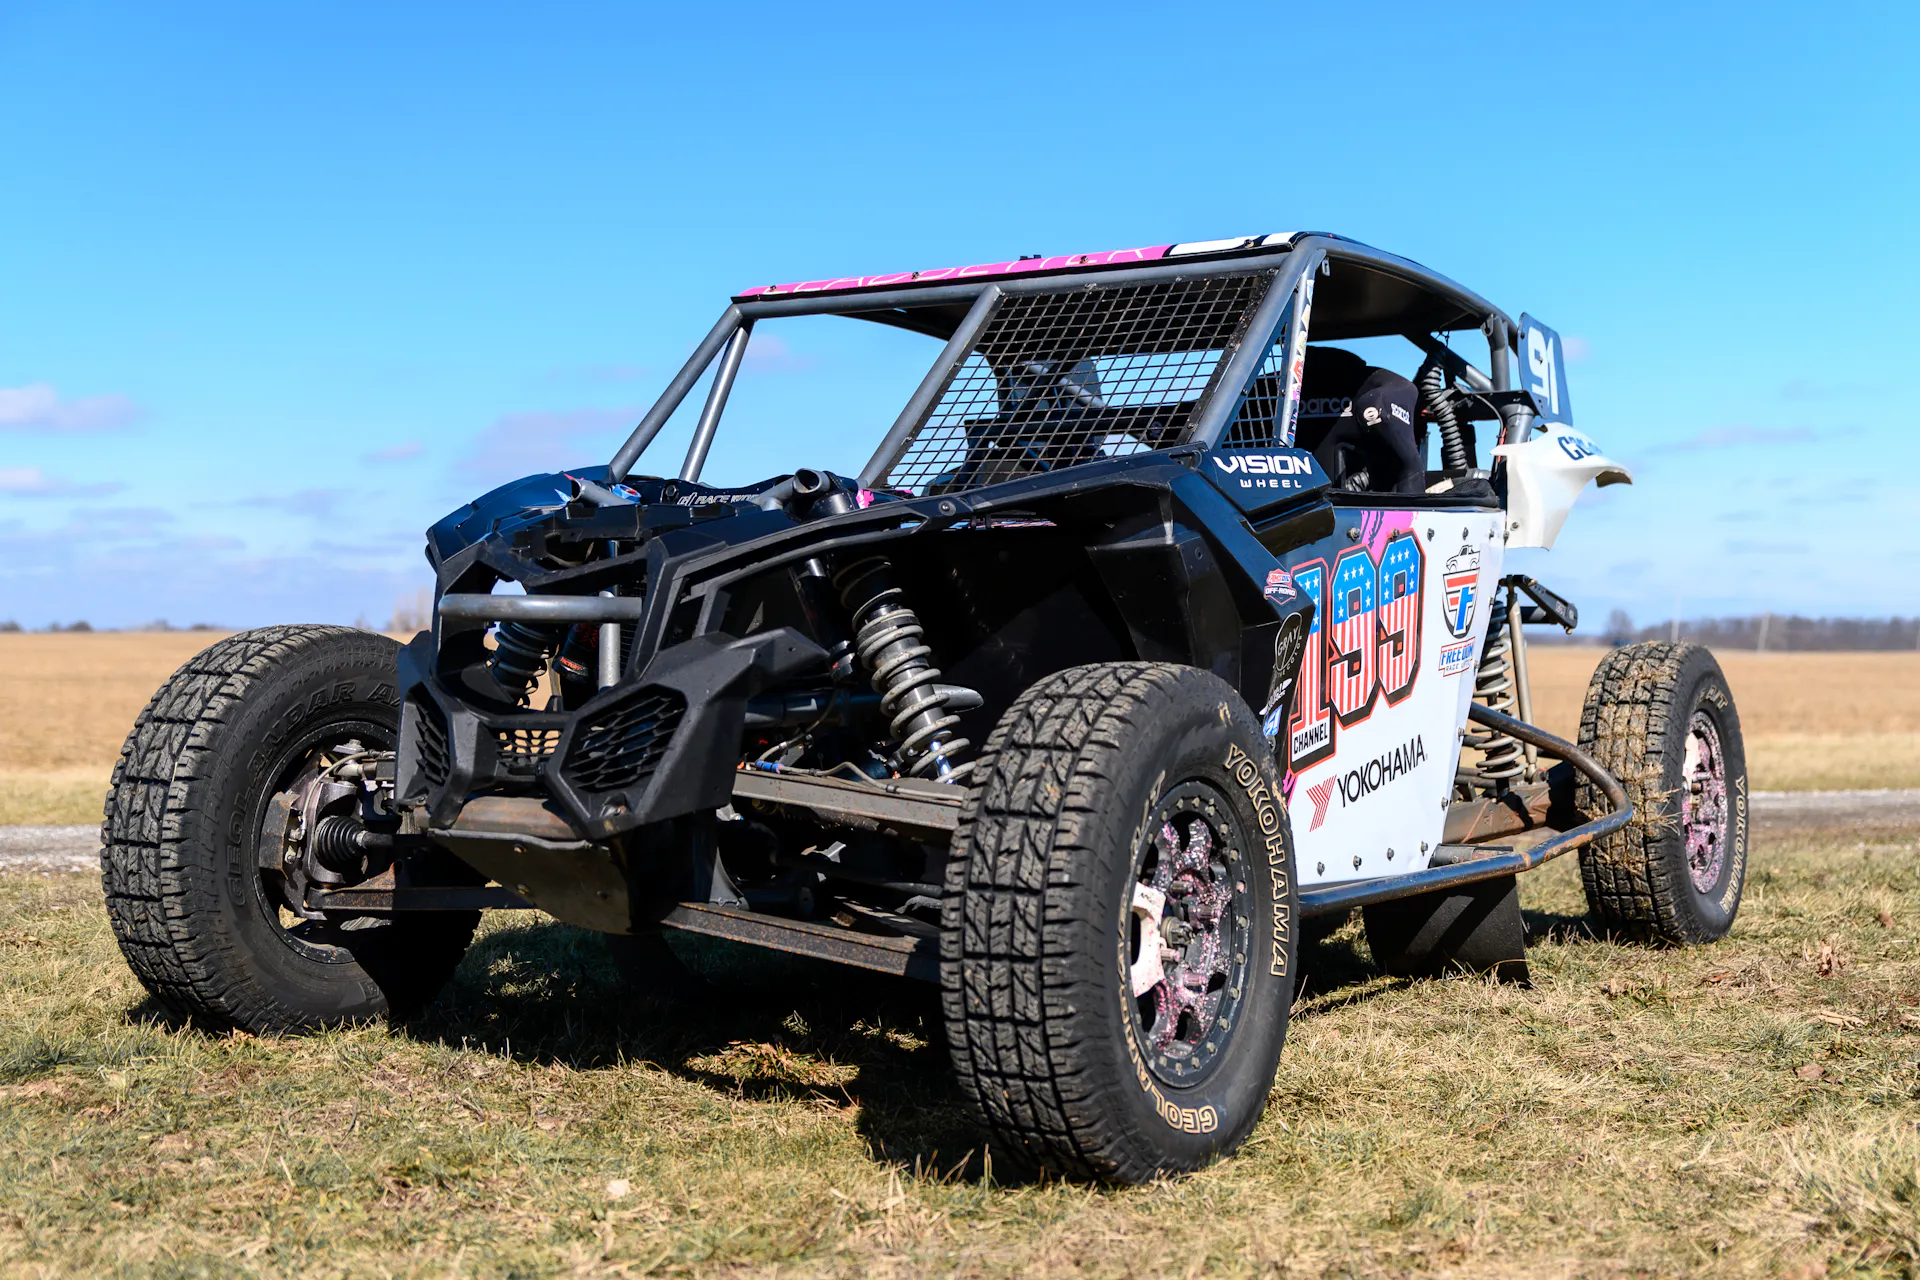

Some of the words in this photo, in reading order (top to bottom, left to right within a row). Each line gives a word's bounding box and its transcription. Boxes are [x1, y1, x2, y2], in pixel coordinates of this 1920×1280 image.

[1300, 396, 1353, 415] arco
[1213, 455, 1313, 475] VISION
[1240, 479, 1302, 488] WHEEL
[1289, 530, 1425, 732] 199
[1441, 643, 1474, 666] FREEDOM
[1294, 722, 1328, 754] CHANNEL
[1337, 734, 1425, 808] YOKOHAMA
[1222, 743, 1289, 977] YOKOHAMA
[1719, 775, 1748, 915] YOKOHAMA
